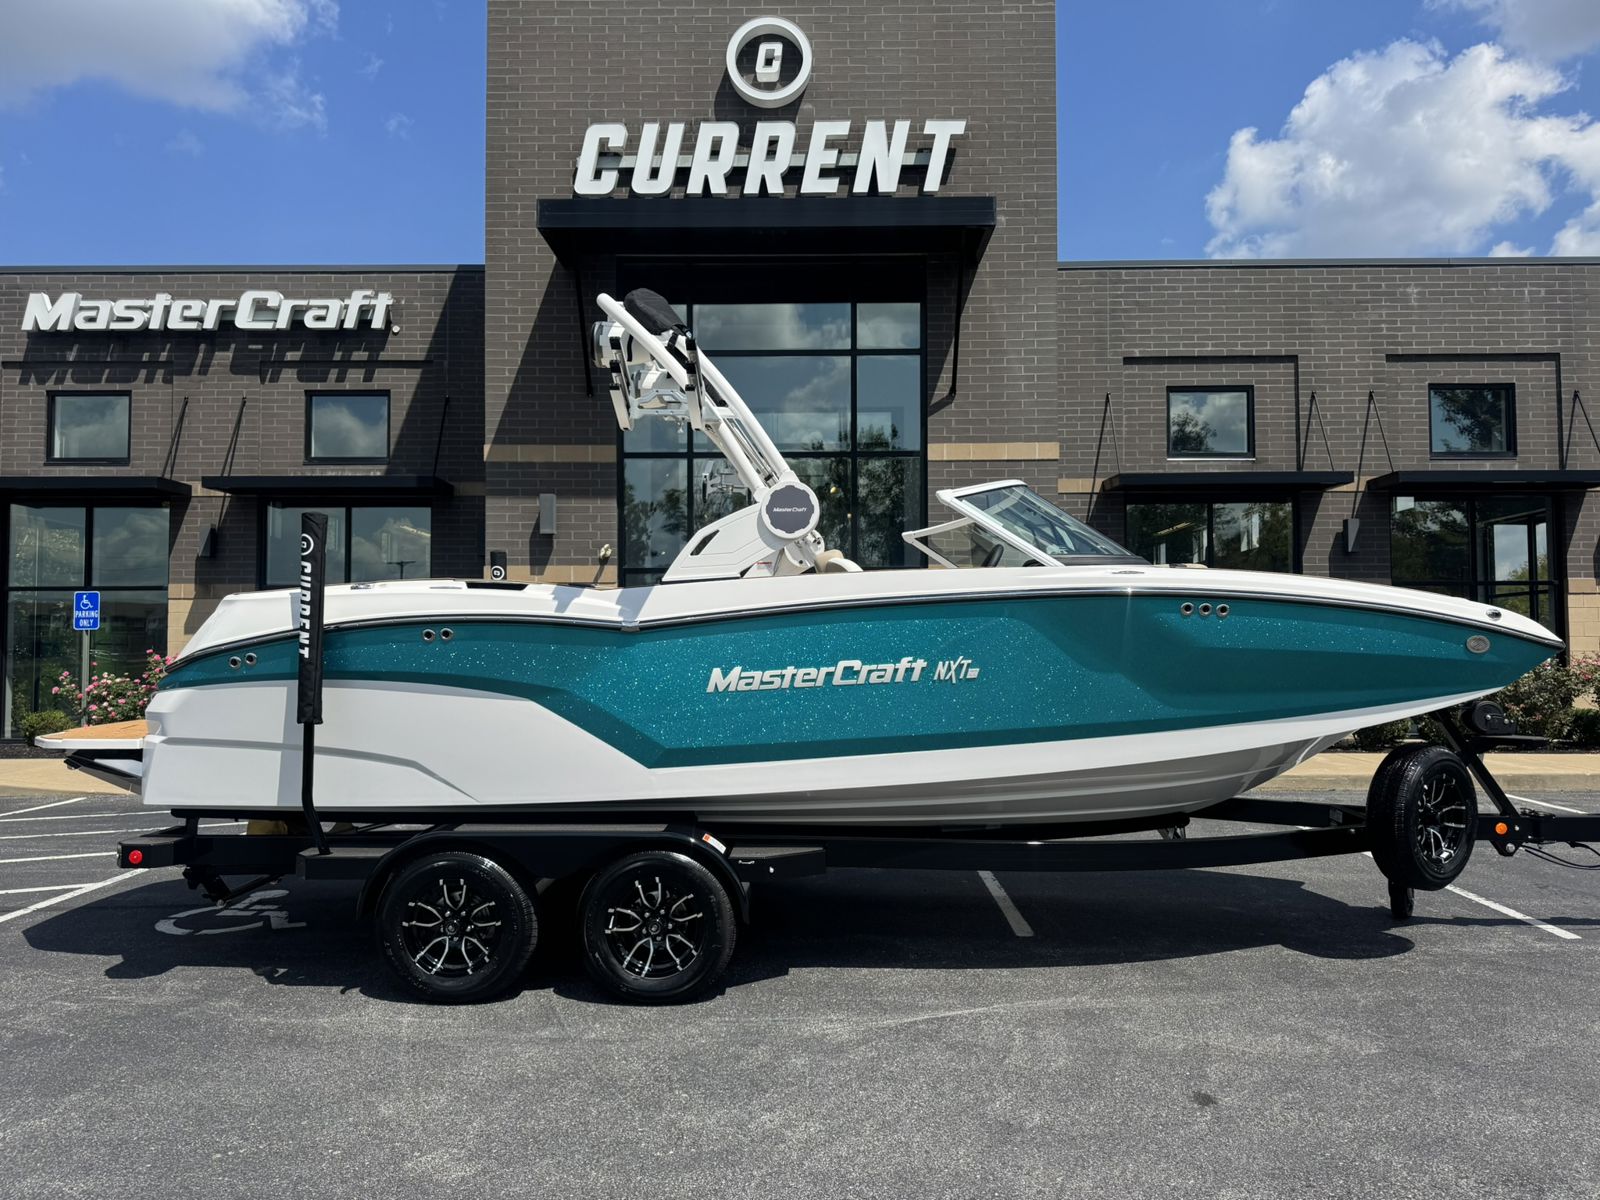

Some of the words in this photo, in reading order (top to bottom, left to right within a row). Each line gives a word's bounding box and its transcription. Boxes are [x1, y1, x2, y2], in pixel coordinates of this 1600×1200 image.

[573, 119, 967, 195] CURRENT
[21, 289, 394, 332] MasterCraft
[75, 610, 98, 618] PARKING
[79, 619, 94, 627] ONLY
[706, 656, 928, 693] MasterCraft
